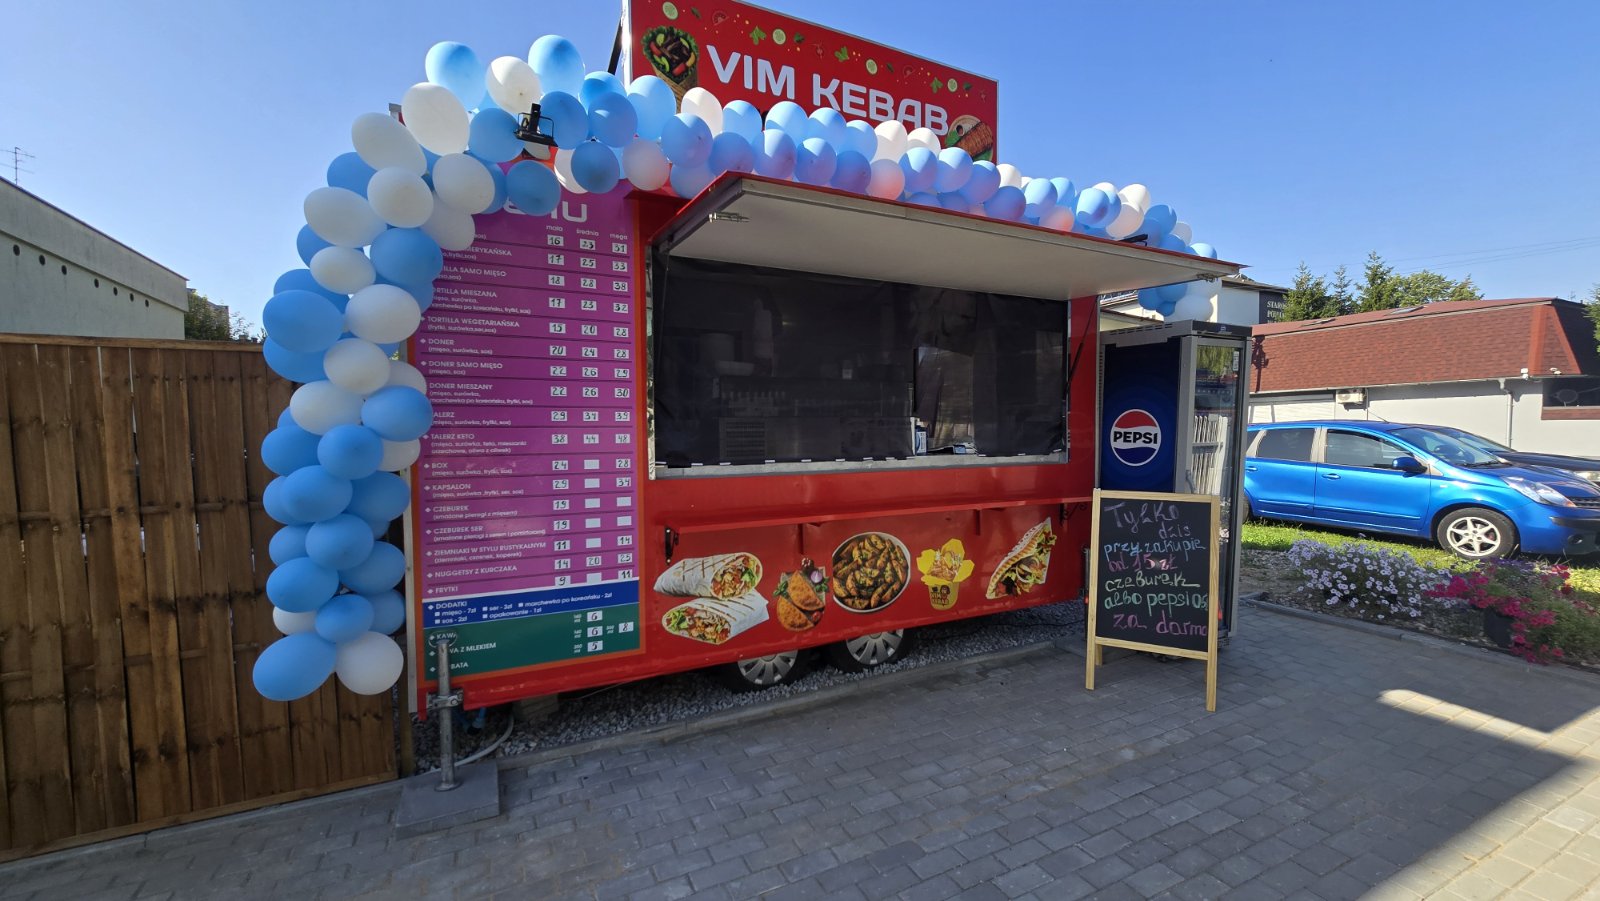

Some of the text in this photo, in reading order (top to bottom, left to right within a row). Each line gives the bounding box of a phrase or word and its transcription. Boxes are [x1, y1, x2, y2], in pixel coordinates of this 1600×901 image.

[706, 45, 949, 136] VIM KEBAB
[549, 236, 561, 245] 16
[549, 254, 626, 271] 17 25 33
[460, 266, 482, 275] SAMO
[484, 269, 507, 277] MIĘSO
[550, 276, 627, 291] 18 28 38
[461, 289, 498, 298] MIESZANA
[550, 298, 563, 307] 17
[614, 303, 628, 312] 32
[428, 315, 520, 328] TORTILLA WEGETARIAŃSKA
[551, 323, 563, 333] 15
[583, 325, 596, 334] 20
[428, 338, 454, 346] DONER
[551, 345, 564, 355] 20
[583, 347, 595, 357] 24
[428, 360, 503, 370] DONER SAMO MIĘSO
[552, 366, 567, 375] 22
[583, 367, 597, 377] 26
[429, 382, 455, 390] DONER
[552, 387, 629, 397] 22 26 30
[552, 411, 566, 420] 29
[585, 435, 596, 443] 44
[1113, 431, 1158, 445] PEPSI
[554, 459, 629, 470] 24 28
[432, 483, 471, 491] KAPSALON
[432, 504, 470, 513] CZEBUREK
[554, 500, 567, 509] 19
[555, 520, 568, 530] 19
[433, 526, 469, 535] CZEBUREK
[556, 536, 631, 550] 11 14
[434, 548, 470, 557] ZIEMNIAKI
[479, 545, 499, 553] STYLU
[499, 542, 547, 552] RUSTYKALNYM
[1104, 538, 1206, 562] przy zakupie
[556, 554, 631, 569] 14 20 25
[1132, 553, 1156, 573] 15
[434, 568, 474, 578] NUGGETSY
[480, 565, 517, 574] KURCZAKA
[621, 570, 631, 579] 11
[435, 586, 459, 594] FRYTKI
[435, 600, 468, 610] DODATKI
[524, 598, 561, 608] marchewka
[1104, 591, 1142, 610] albo
[1147, 590, 1189, 618] pepsi
[441, 609, 462, 617] mięso
[1113, 613, 1147, 630] za
[465, 642, 497, 652] MLEKIEM
[450, 661, 469, 670] BATA
